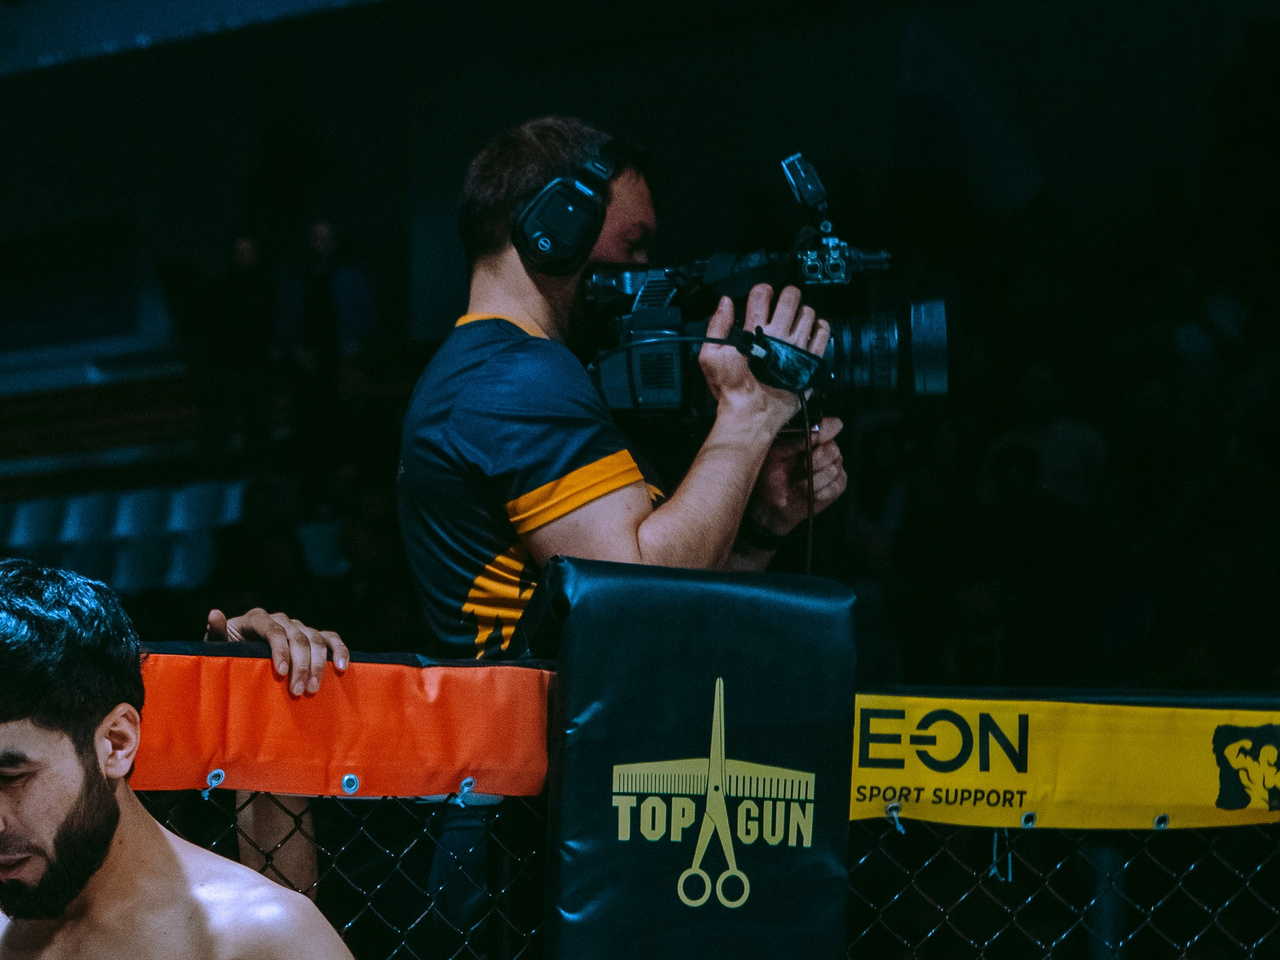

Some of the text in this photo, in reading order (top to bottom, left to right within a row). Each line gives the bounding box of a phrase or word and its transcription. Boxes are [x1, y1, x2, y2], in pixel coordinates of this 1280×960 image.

[855, 785, 1027, 808] SPORT SUPPORT
[612, 795, 814, 847] TOP GUN
